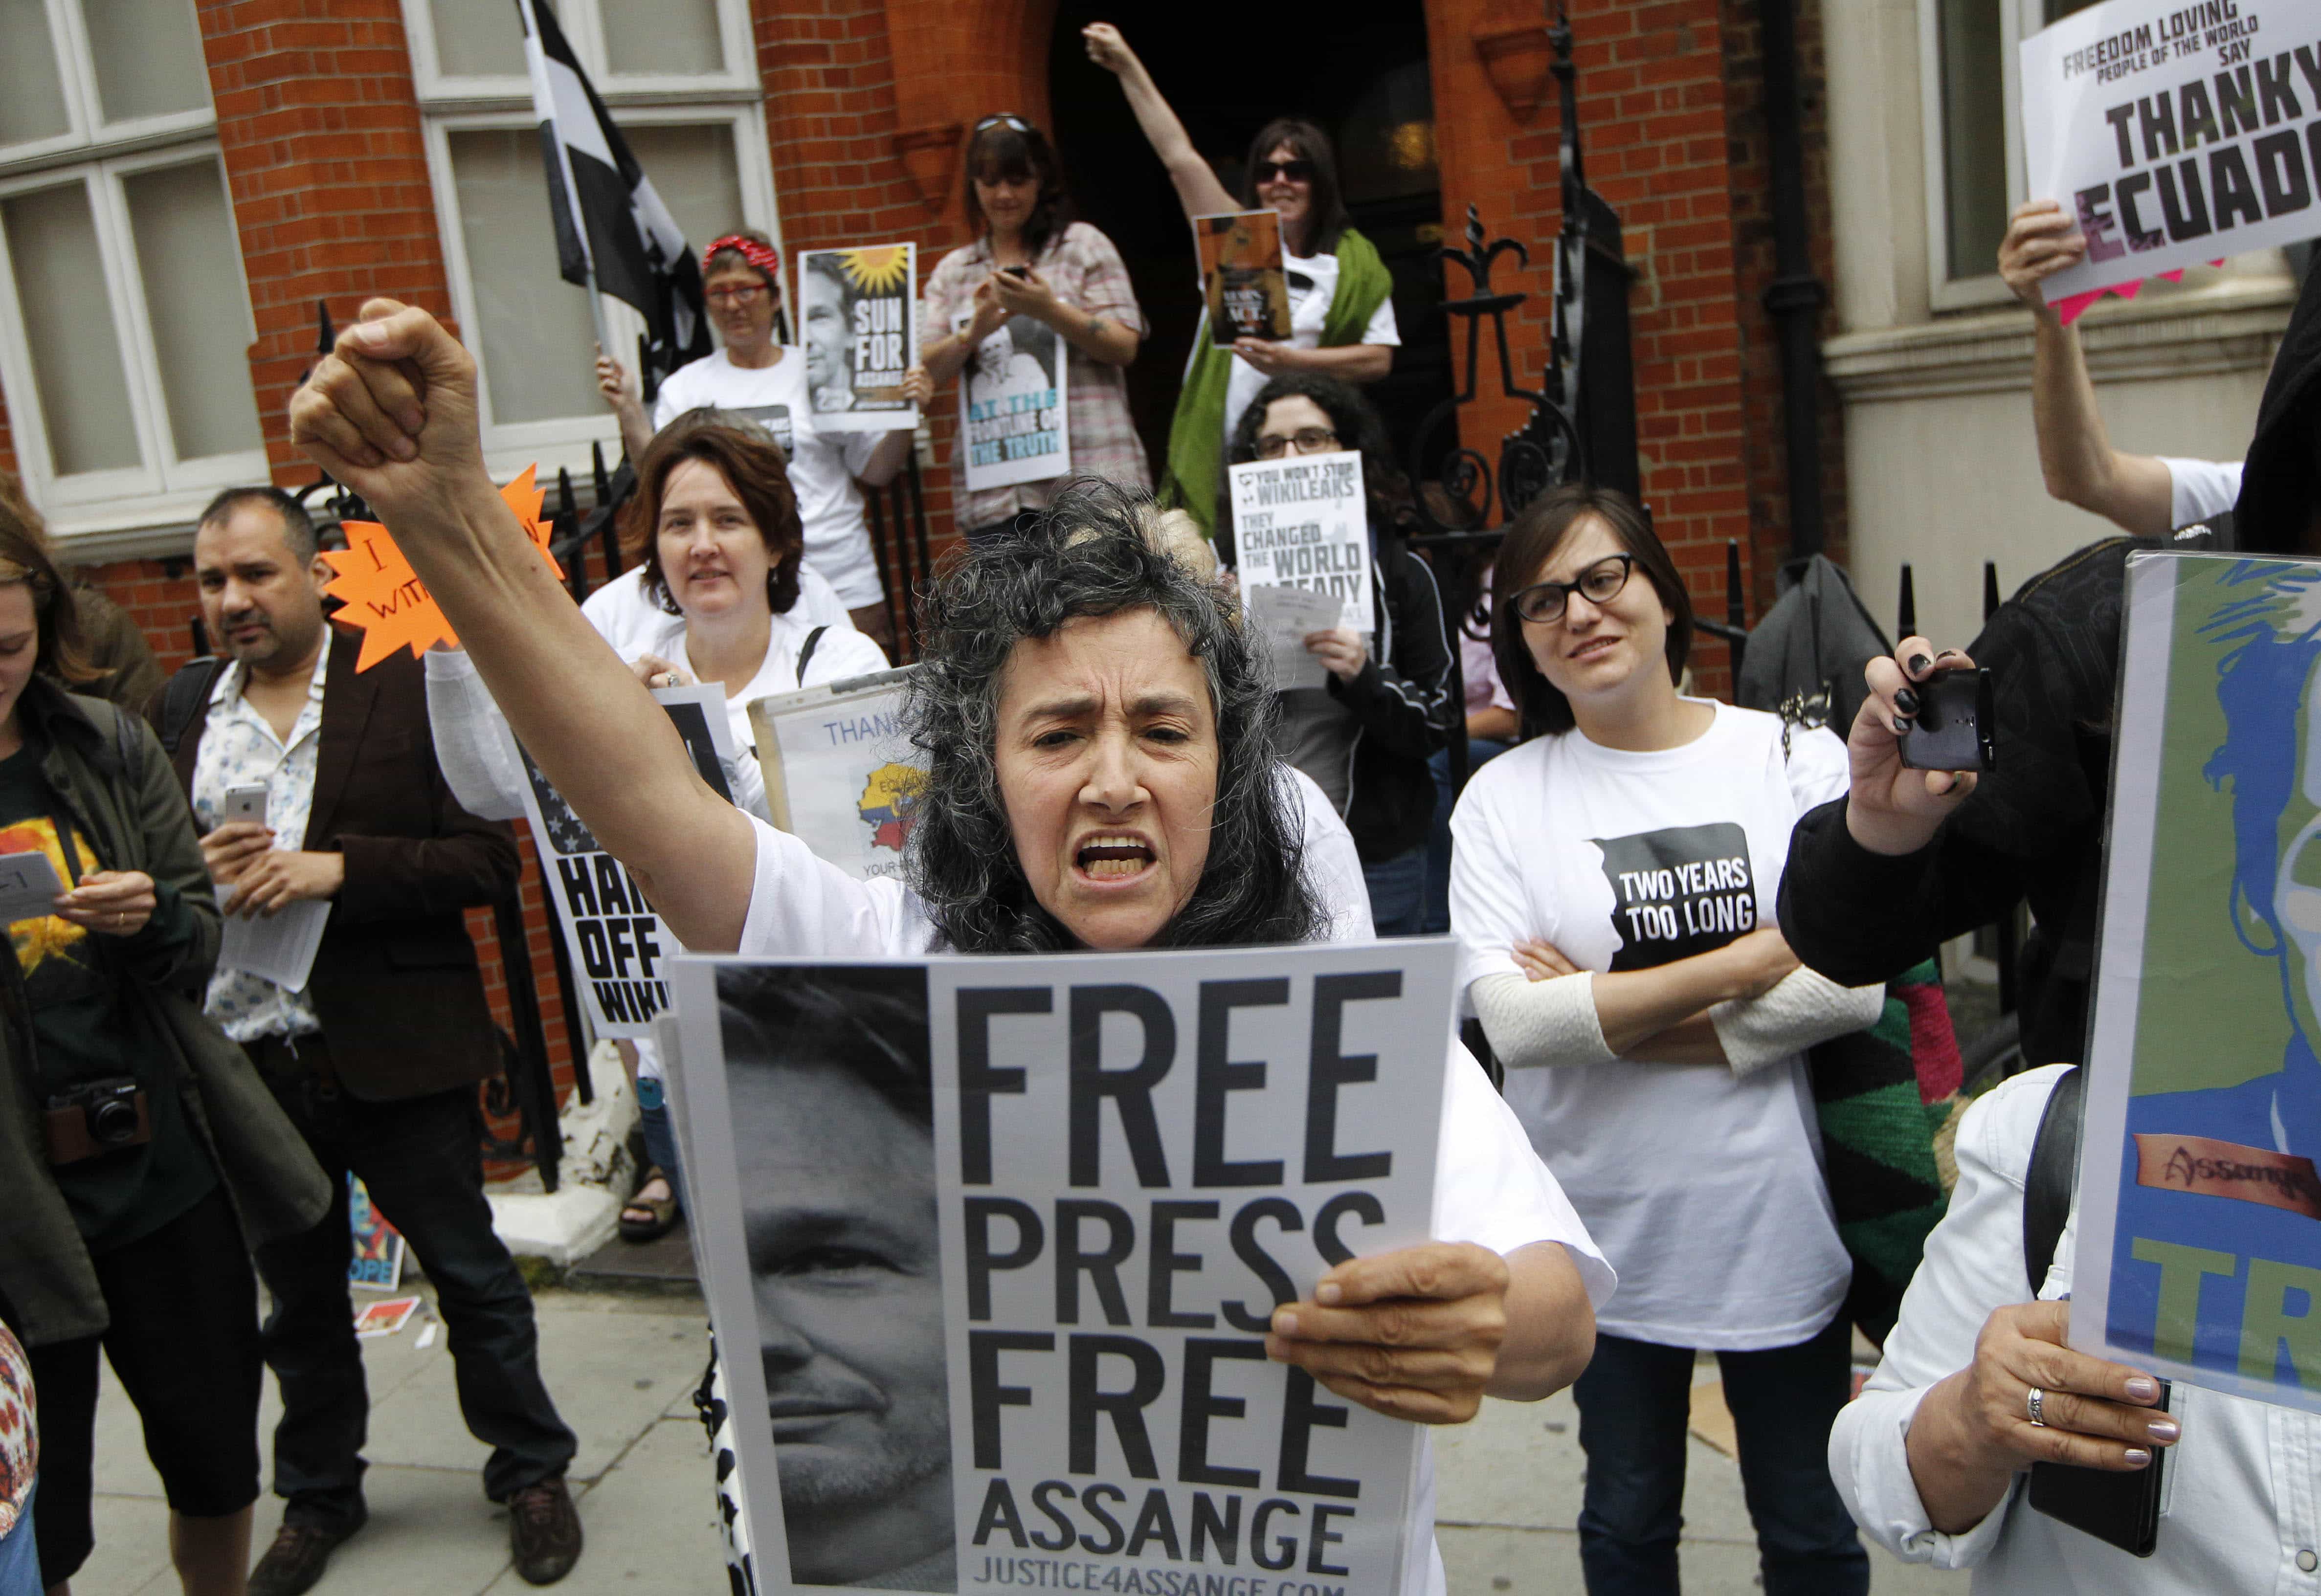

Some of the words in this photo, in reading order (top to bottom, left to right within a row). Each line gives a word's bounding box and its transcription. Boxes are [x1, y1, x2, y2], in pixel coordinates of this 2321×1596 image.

[2062, 23, 2152, 81] FREEDOM
[2157, 0, 2238, 43] LOVING
[2097, 52, 2147, 86] PEOPLE
[2152, 45, 2168, 66] OF
[2174, 35, 2200, 58] THE
[2205, 14, 2259, 47] WORLD
[2219, 38, 2251, 66] SAY
[854, 296, 903, 334] SUN
[854, 332, 905, 372] FOR
[1257, 476, 1354, 506] WIKILEAKS
[1241, 512, 1274, 529] THEY
[1243, 524, 1322, 551] CHANGED
[362, 538, 388, 572] I
[1245, 551, 1269, 568] THE
[1273, 543, 1361, 578] WORLD
[824, 711, 901, 746] THAN
[863, 861, 896, 876] YOUR
[1619, 869, 1675, 902] TWO
[1674, 857, 1749, 895] YEARS
[1625, 905, 1678, 942] TOO
[1684, 892, 1754, 936] LONG
[576, 917, 661, 978] OFF
[956, 970, 1403, 1188] FREE
[968, 1329, 1361, 1499] FREE
[972, 1477, 1358, 1576] ASSANGE
